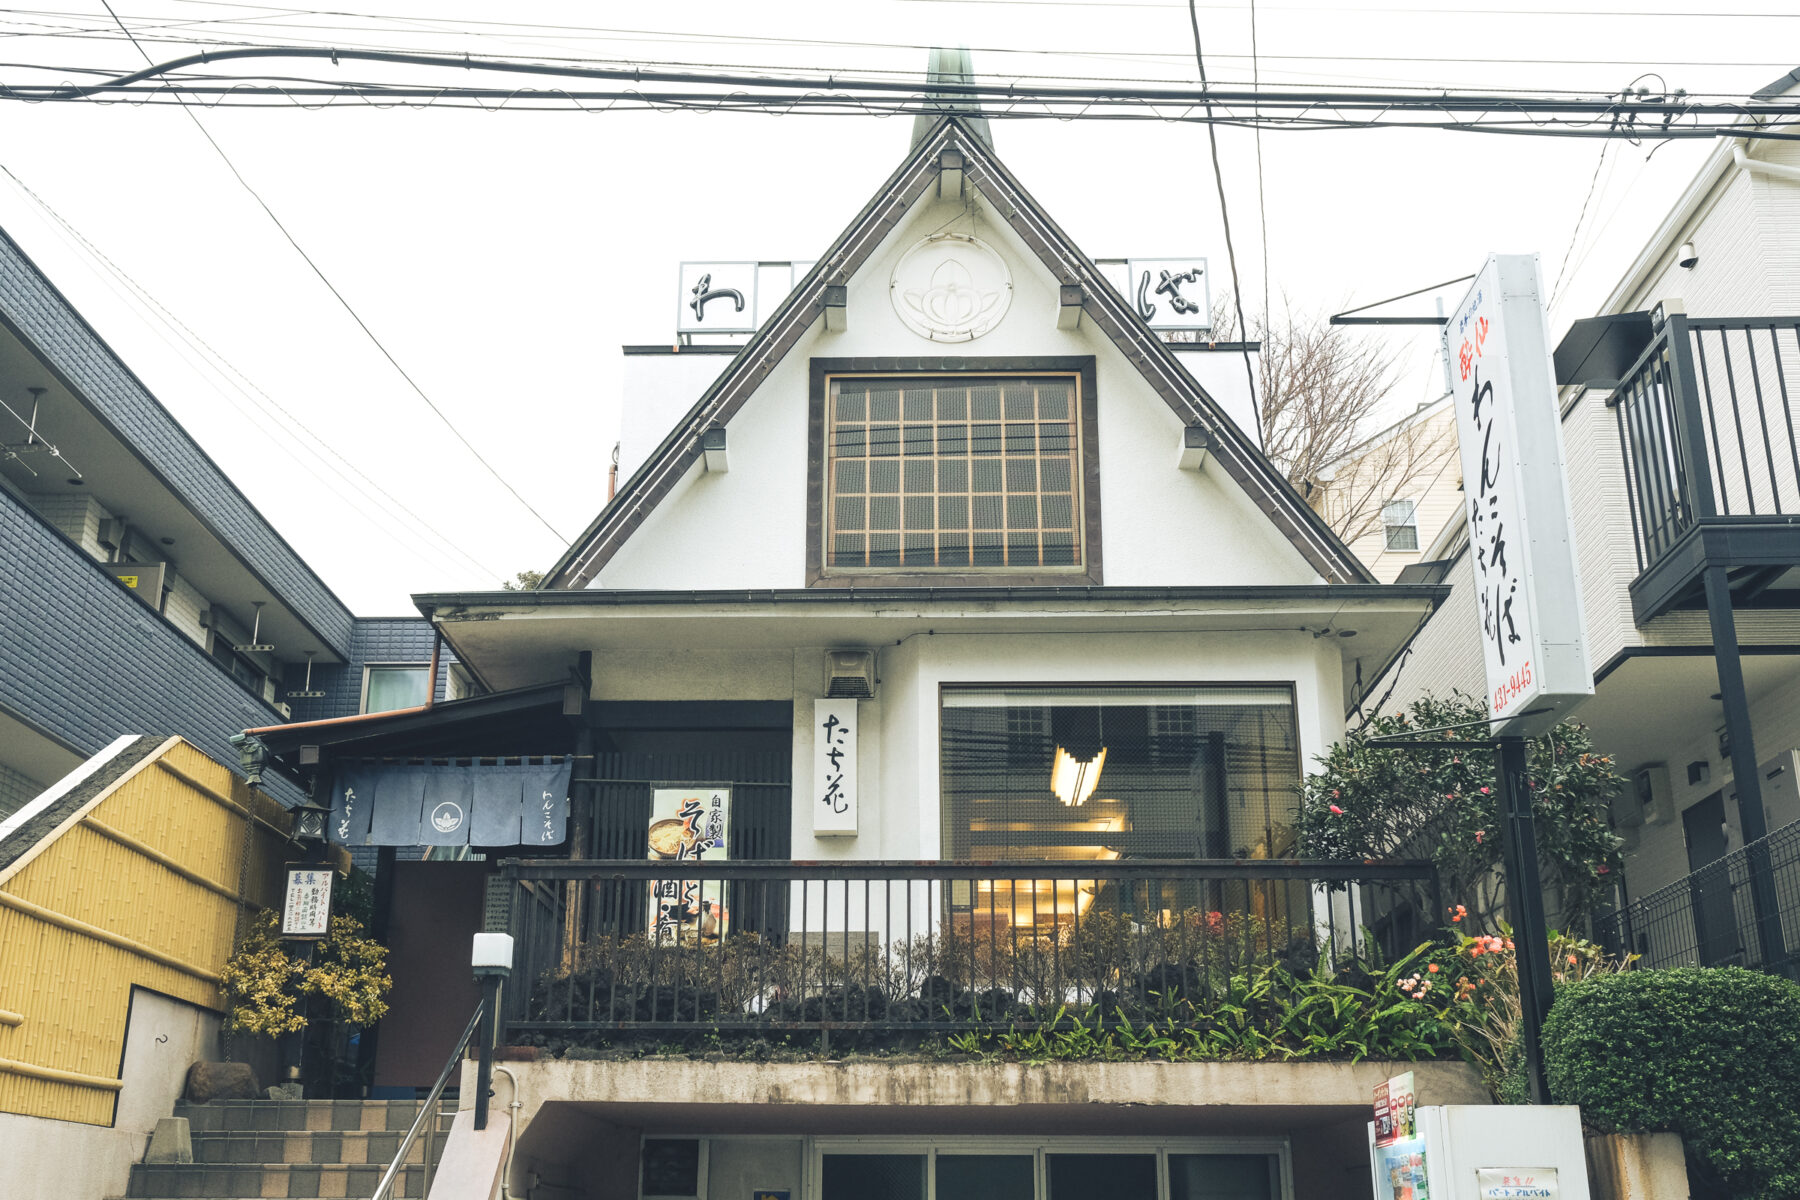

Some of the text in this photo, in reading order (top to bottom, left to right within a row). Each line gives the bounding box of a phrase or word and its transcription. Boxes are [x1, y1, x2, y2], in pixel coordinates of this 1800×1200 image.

[1137, 267, 1203, 323] ば
[1471, 365, 1521, 666] わんこそば
[1493, 660, 1532, 714] 431-9445
[823, 714, 849, 814] たち花
[709, 794, 723, 840] 自家製
